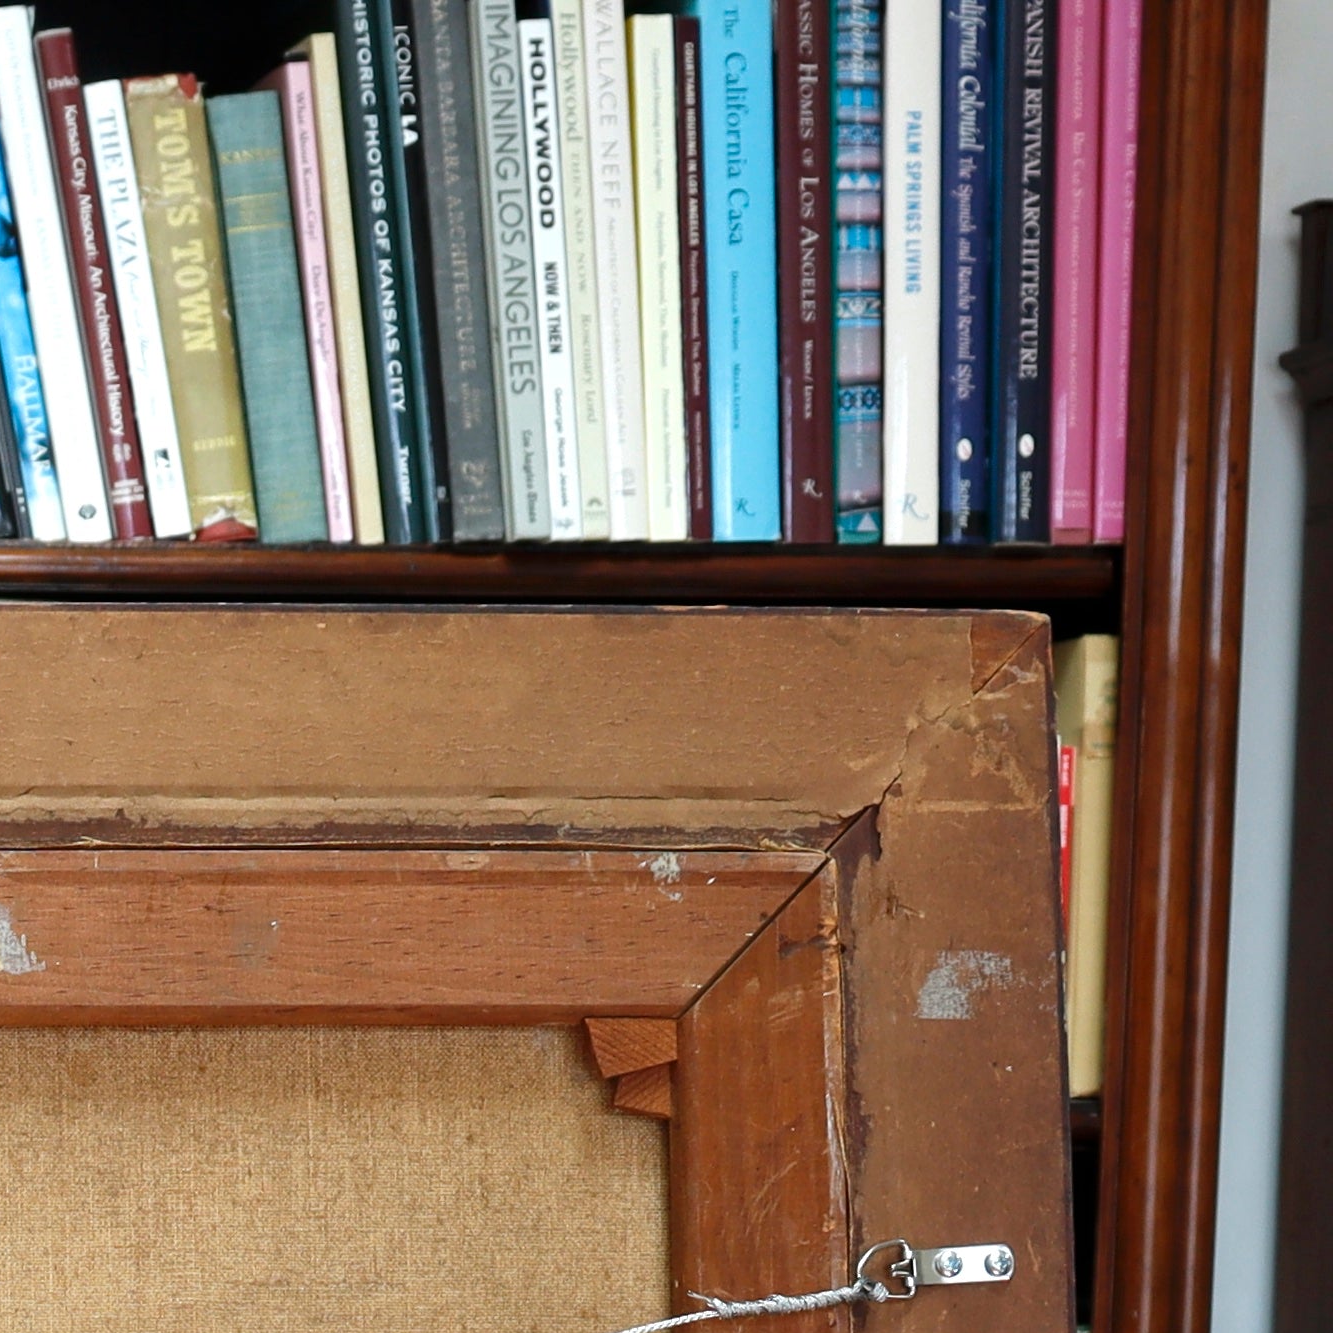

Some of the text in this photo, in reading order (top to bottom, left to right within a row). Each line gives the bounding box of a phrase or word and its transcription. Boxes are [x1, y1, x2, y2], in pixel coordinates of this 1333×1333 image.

[95, 109, 125, 171] THE
[293, 91, 315, 209] What Kansas
[393, 25, 420, 147] ICONIC LA
[437, 80, 461, 186] BARBARA
[528, 36, 557, 230] HOLLYWOOD
[559, 12, 585, 245] Hollywood THEN AND
[593, 0, 622, 210] WALLACE NEFF
[683, 41, 701, 247] COURTYARD HOUSING ANGELES
[722, 8, 751, 247] The California Casa
[62, 104, 127, 437] Kansas An Architectural History
[105, 177, 139, 269] PLAZA
[152, 107, 216, 353] TOM'S TOWN
[352, 0, 408, 413] HISTORIC PHOTOS OF KANSAS CITY
[446, 195, 477, 373] ARCHITECTURE
[485, 4, 537, 396] IMAGINING LOS ANGELES
[798, 62, 820, 323] HOMES OF LOS ANGELES
[904, 110, 922, 294] PALM SPRINGS LIVING
[951, 74, 986, 400] Colonial Spanish and Rancho Revival Styles
[1019, 87, 1042, 379] REVIVAL ARCHITECTURE
[543, 260, 564, 355] NOW THEN
[579, 312, 600, 425] Rosemary Lord
[398, 445, 413, 505] Turner
[553, 387, 568, 468] George Ross
[958, 478, 973, 529] Schiffer
[1019, 470, 1034, 520] Schiffer
